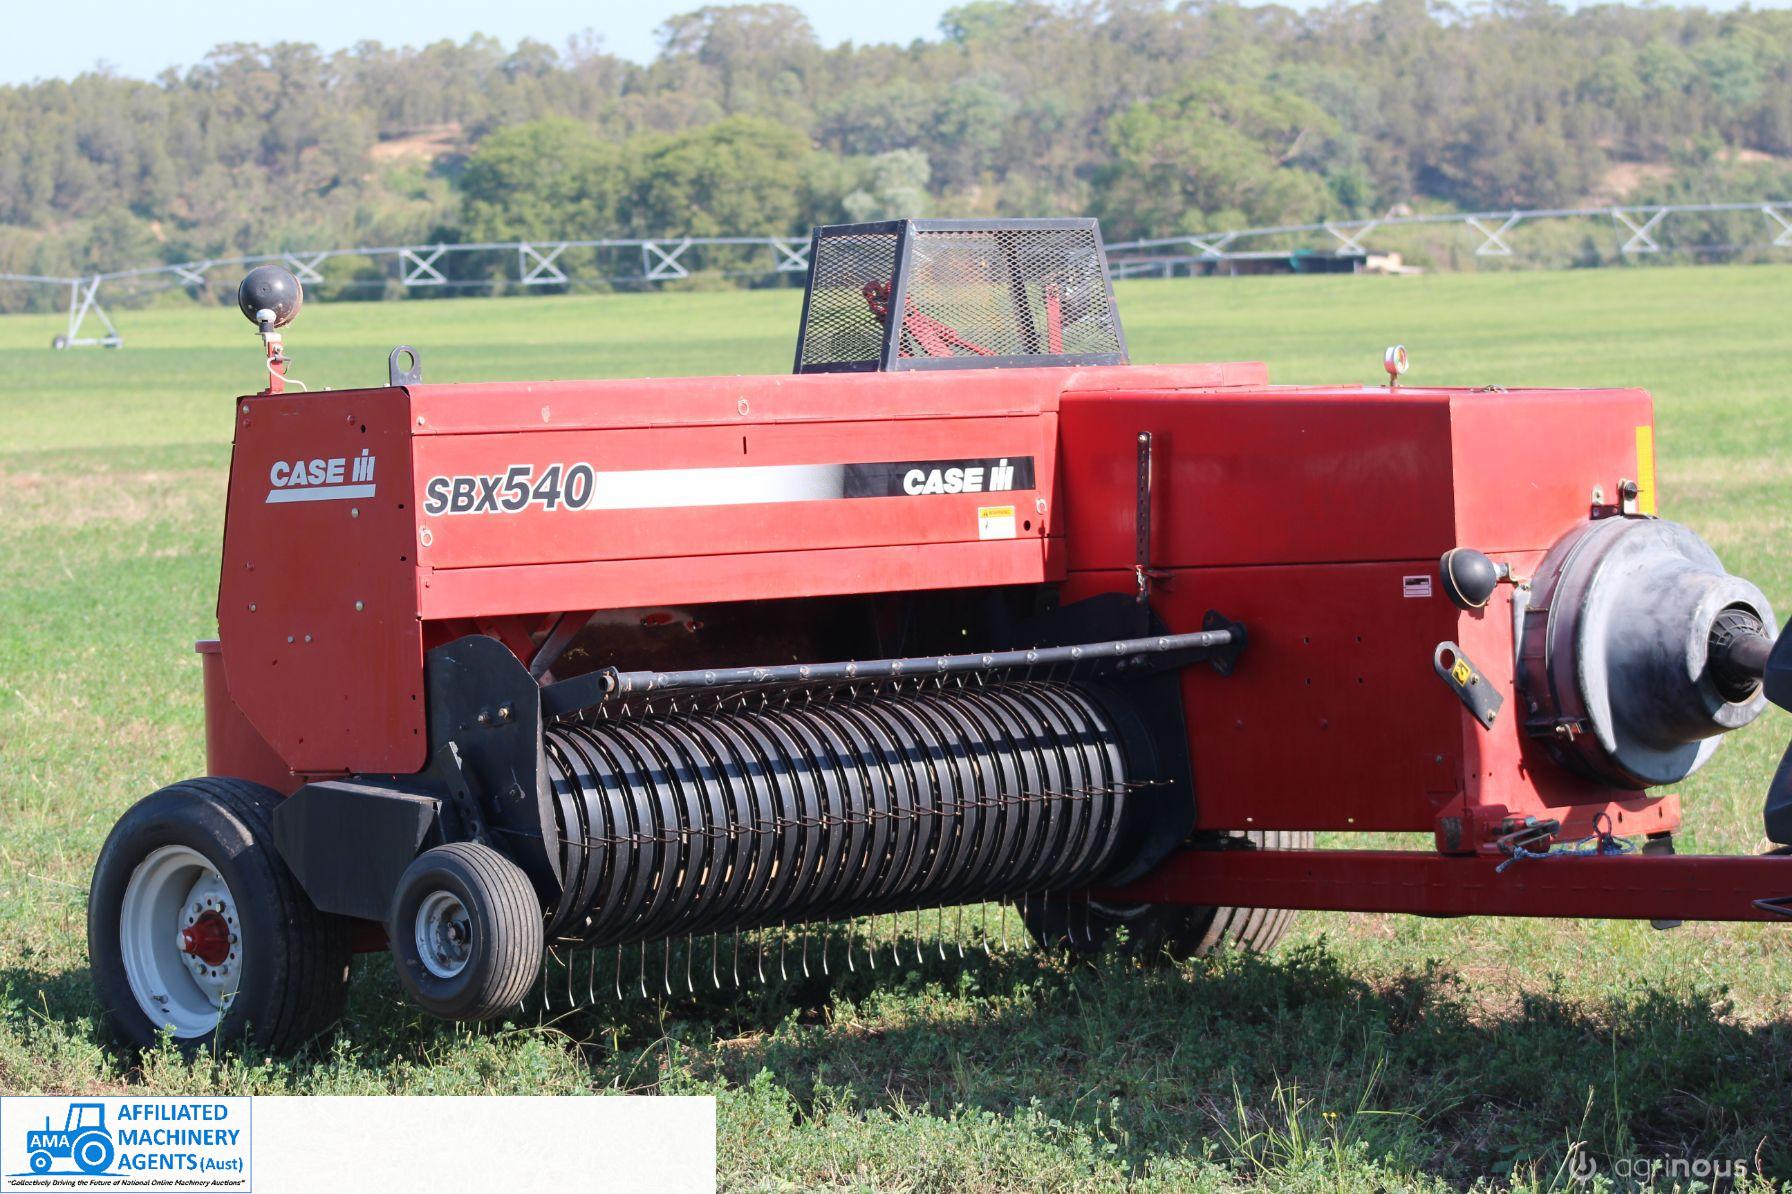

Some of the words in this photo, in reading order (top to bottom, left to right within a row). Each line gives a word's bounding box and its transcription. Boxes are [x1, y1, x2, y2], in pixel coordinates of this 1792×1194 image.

[270, 458, 346, 488] CASE
[424, 462, 595, 514] SBX540
[903, 467, 984, 496] CASE
